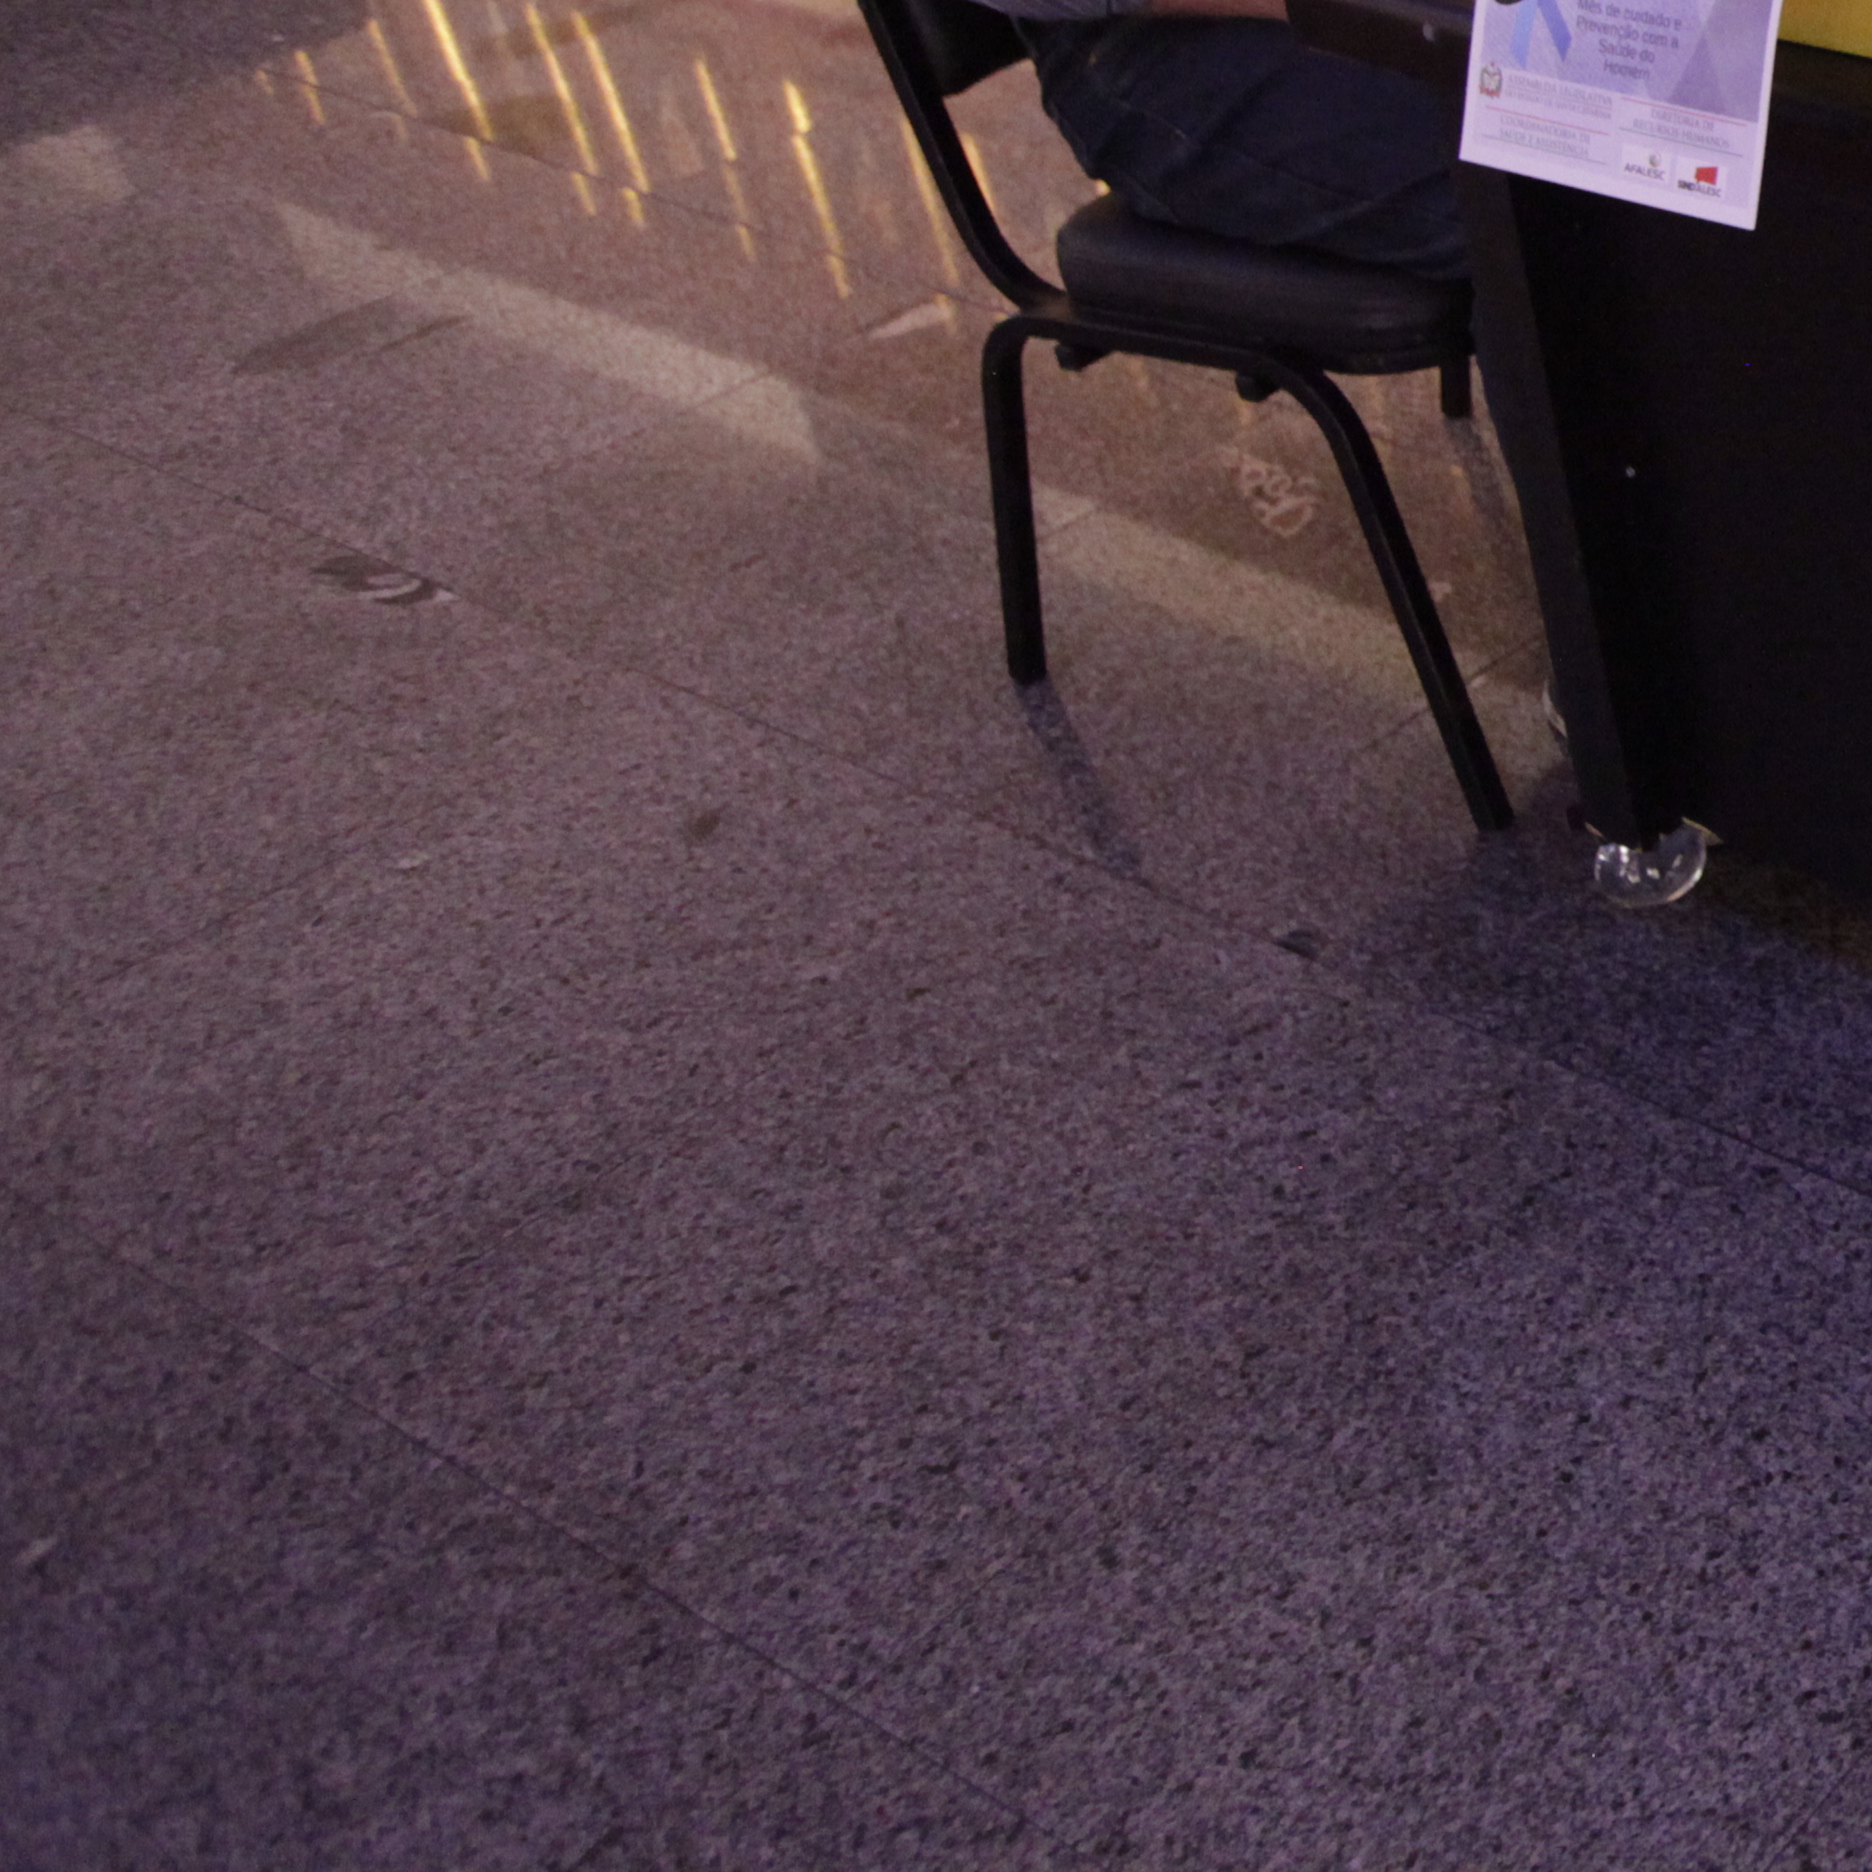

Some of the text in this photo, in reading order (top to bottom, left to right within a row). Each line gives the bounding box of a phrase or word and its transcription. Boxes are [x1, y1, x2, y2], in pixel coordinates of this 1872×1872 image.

[1576, 14, 1680, 50] Prevenção com a
[1606, 3, 1620, 19] de
[1623, 7, 1673, 30] cuidado
[1674, 18, 1683, 33] e
[1598, 38, 1656, 64] Saúde do
[1623, 162, 1666, 181] AFALESC
